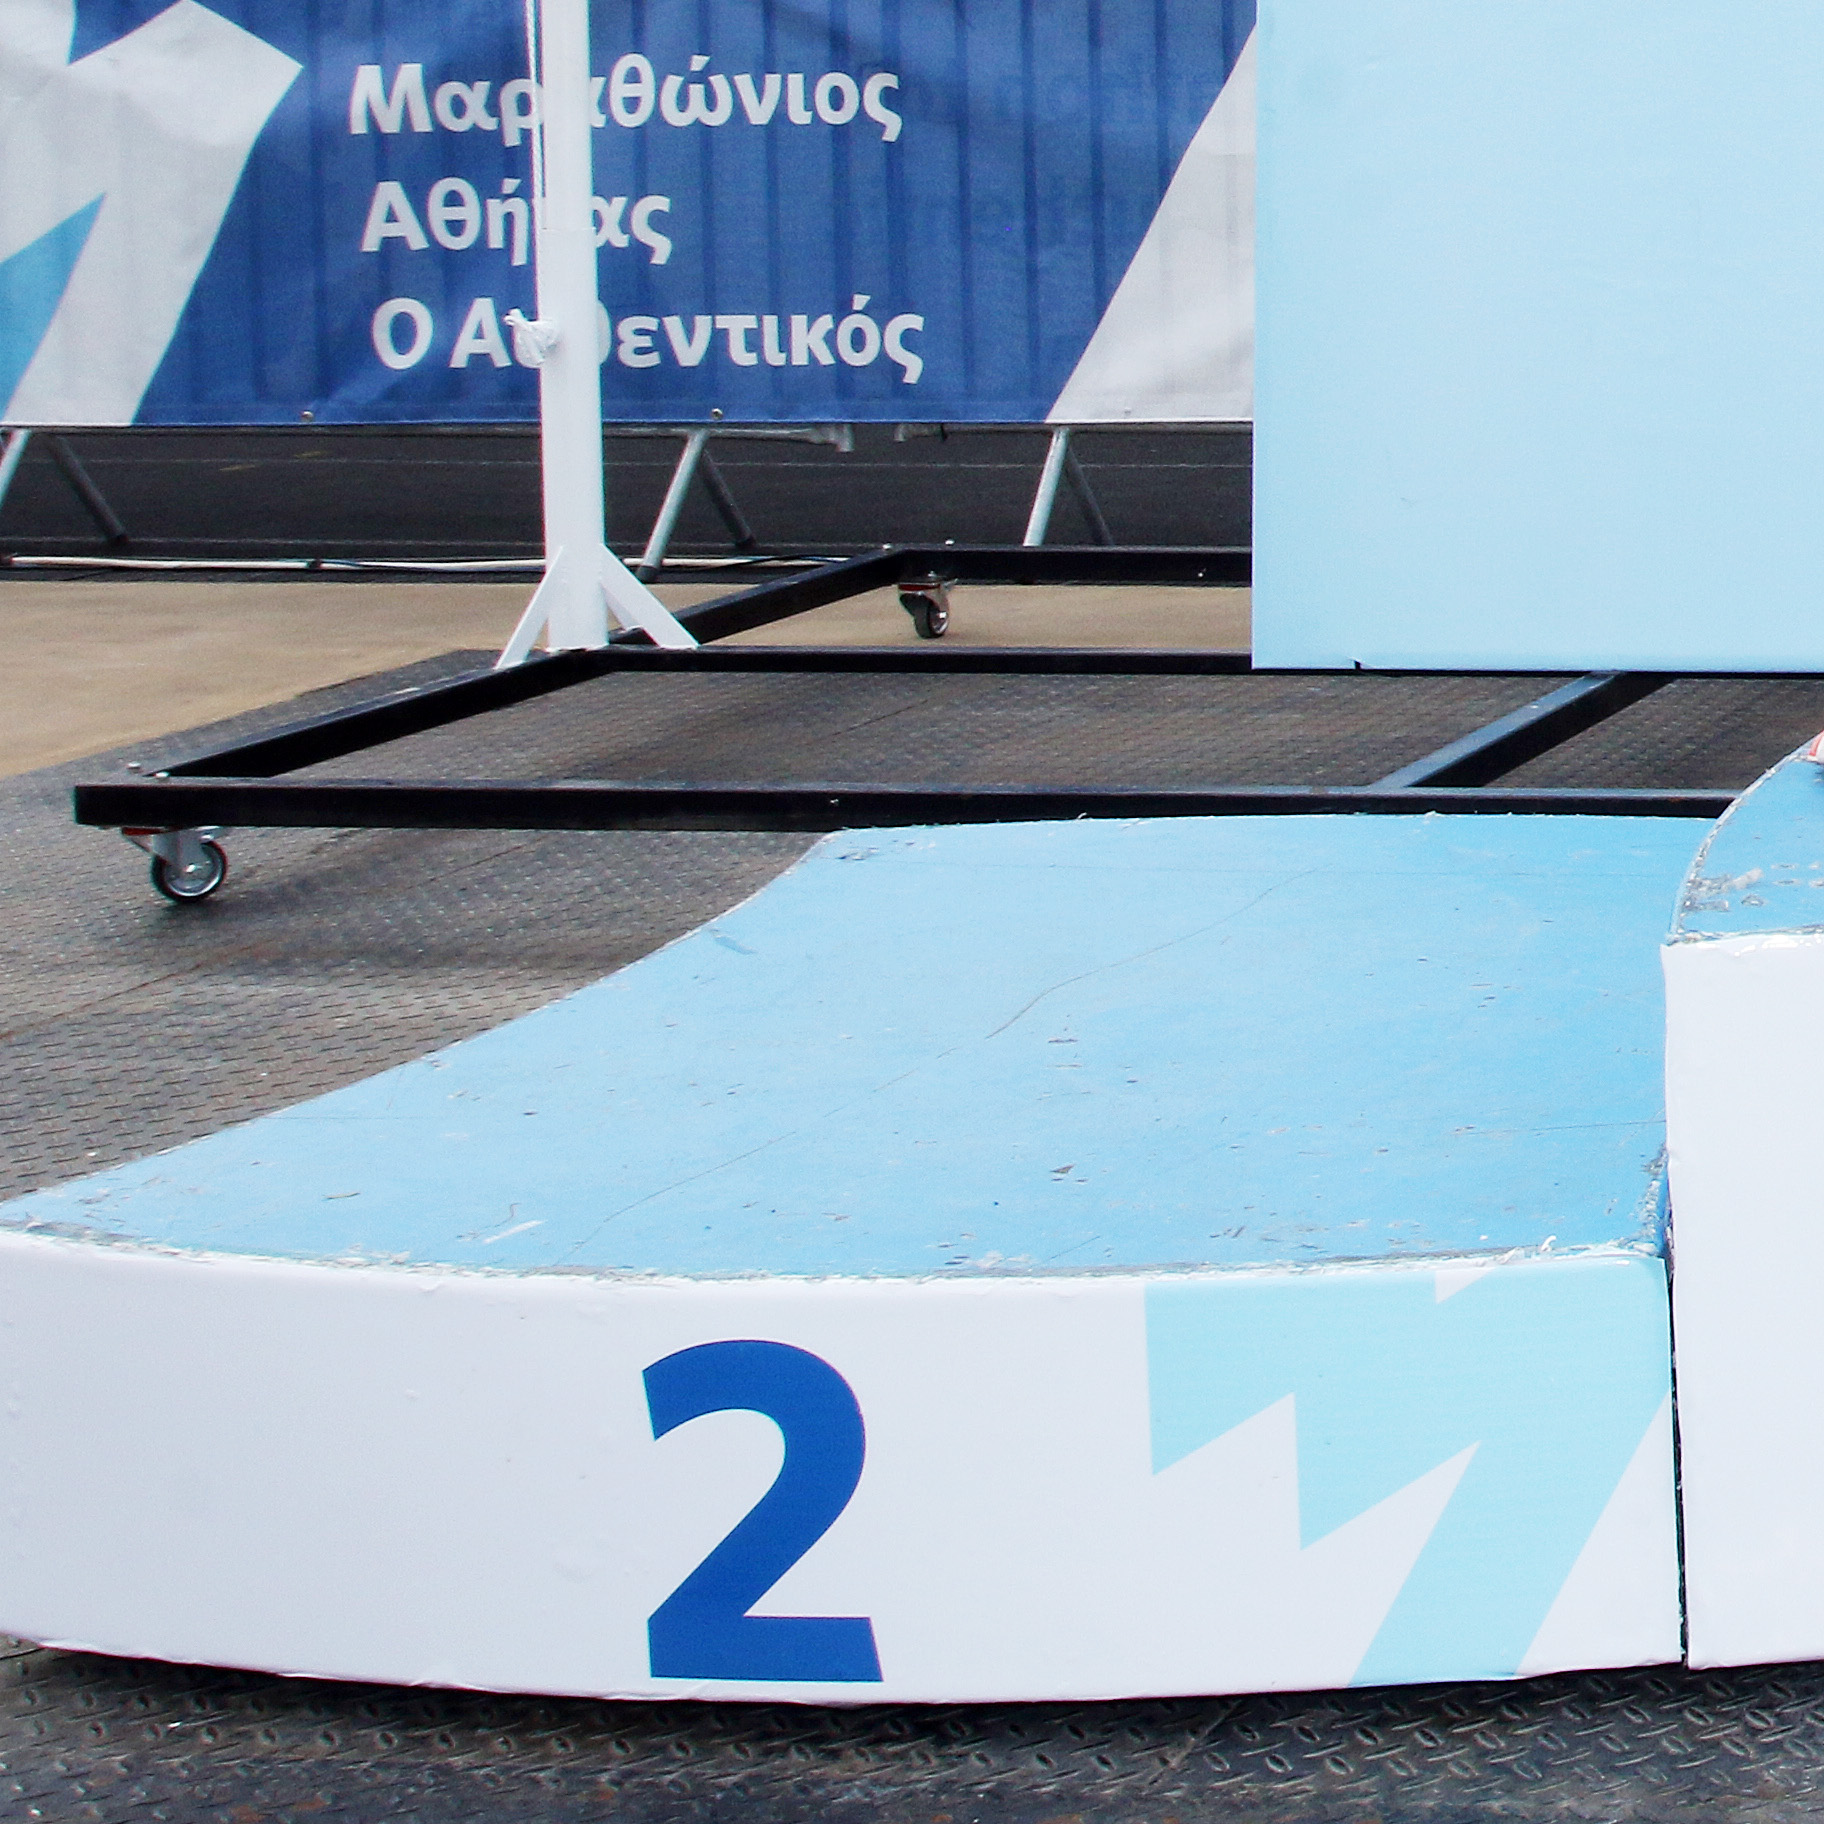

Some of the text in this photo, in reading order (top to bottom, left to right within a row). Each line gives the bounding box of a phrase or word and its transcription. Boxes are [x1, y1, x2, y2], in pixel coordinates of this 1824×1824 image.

[350, 53, 902, 148] Μαρθώνιος
[361, 177, 672, 266] Αθήας
[372, 293, 924, 384] Ο Αεντικός
[641, 1340, 883, 1684] 2
